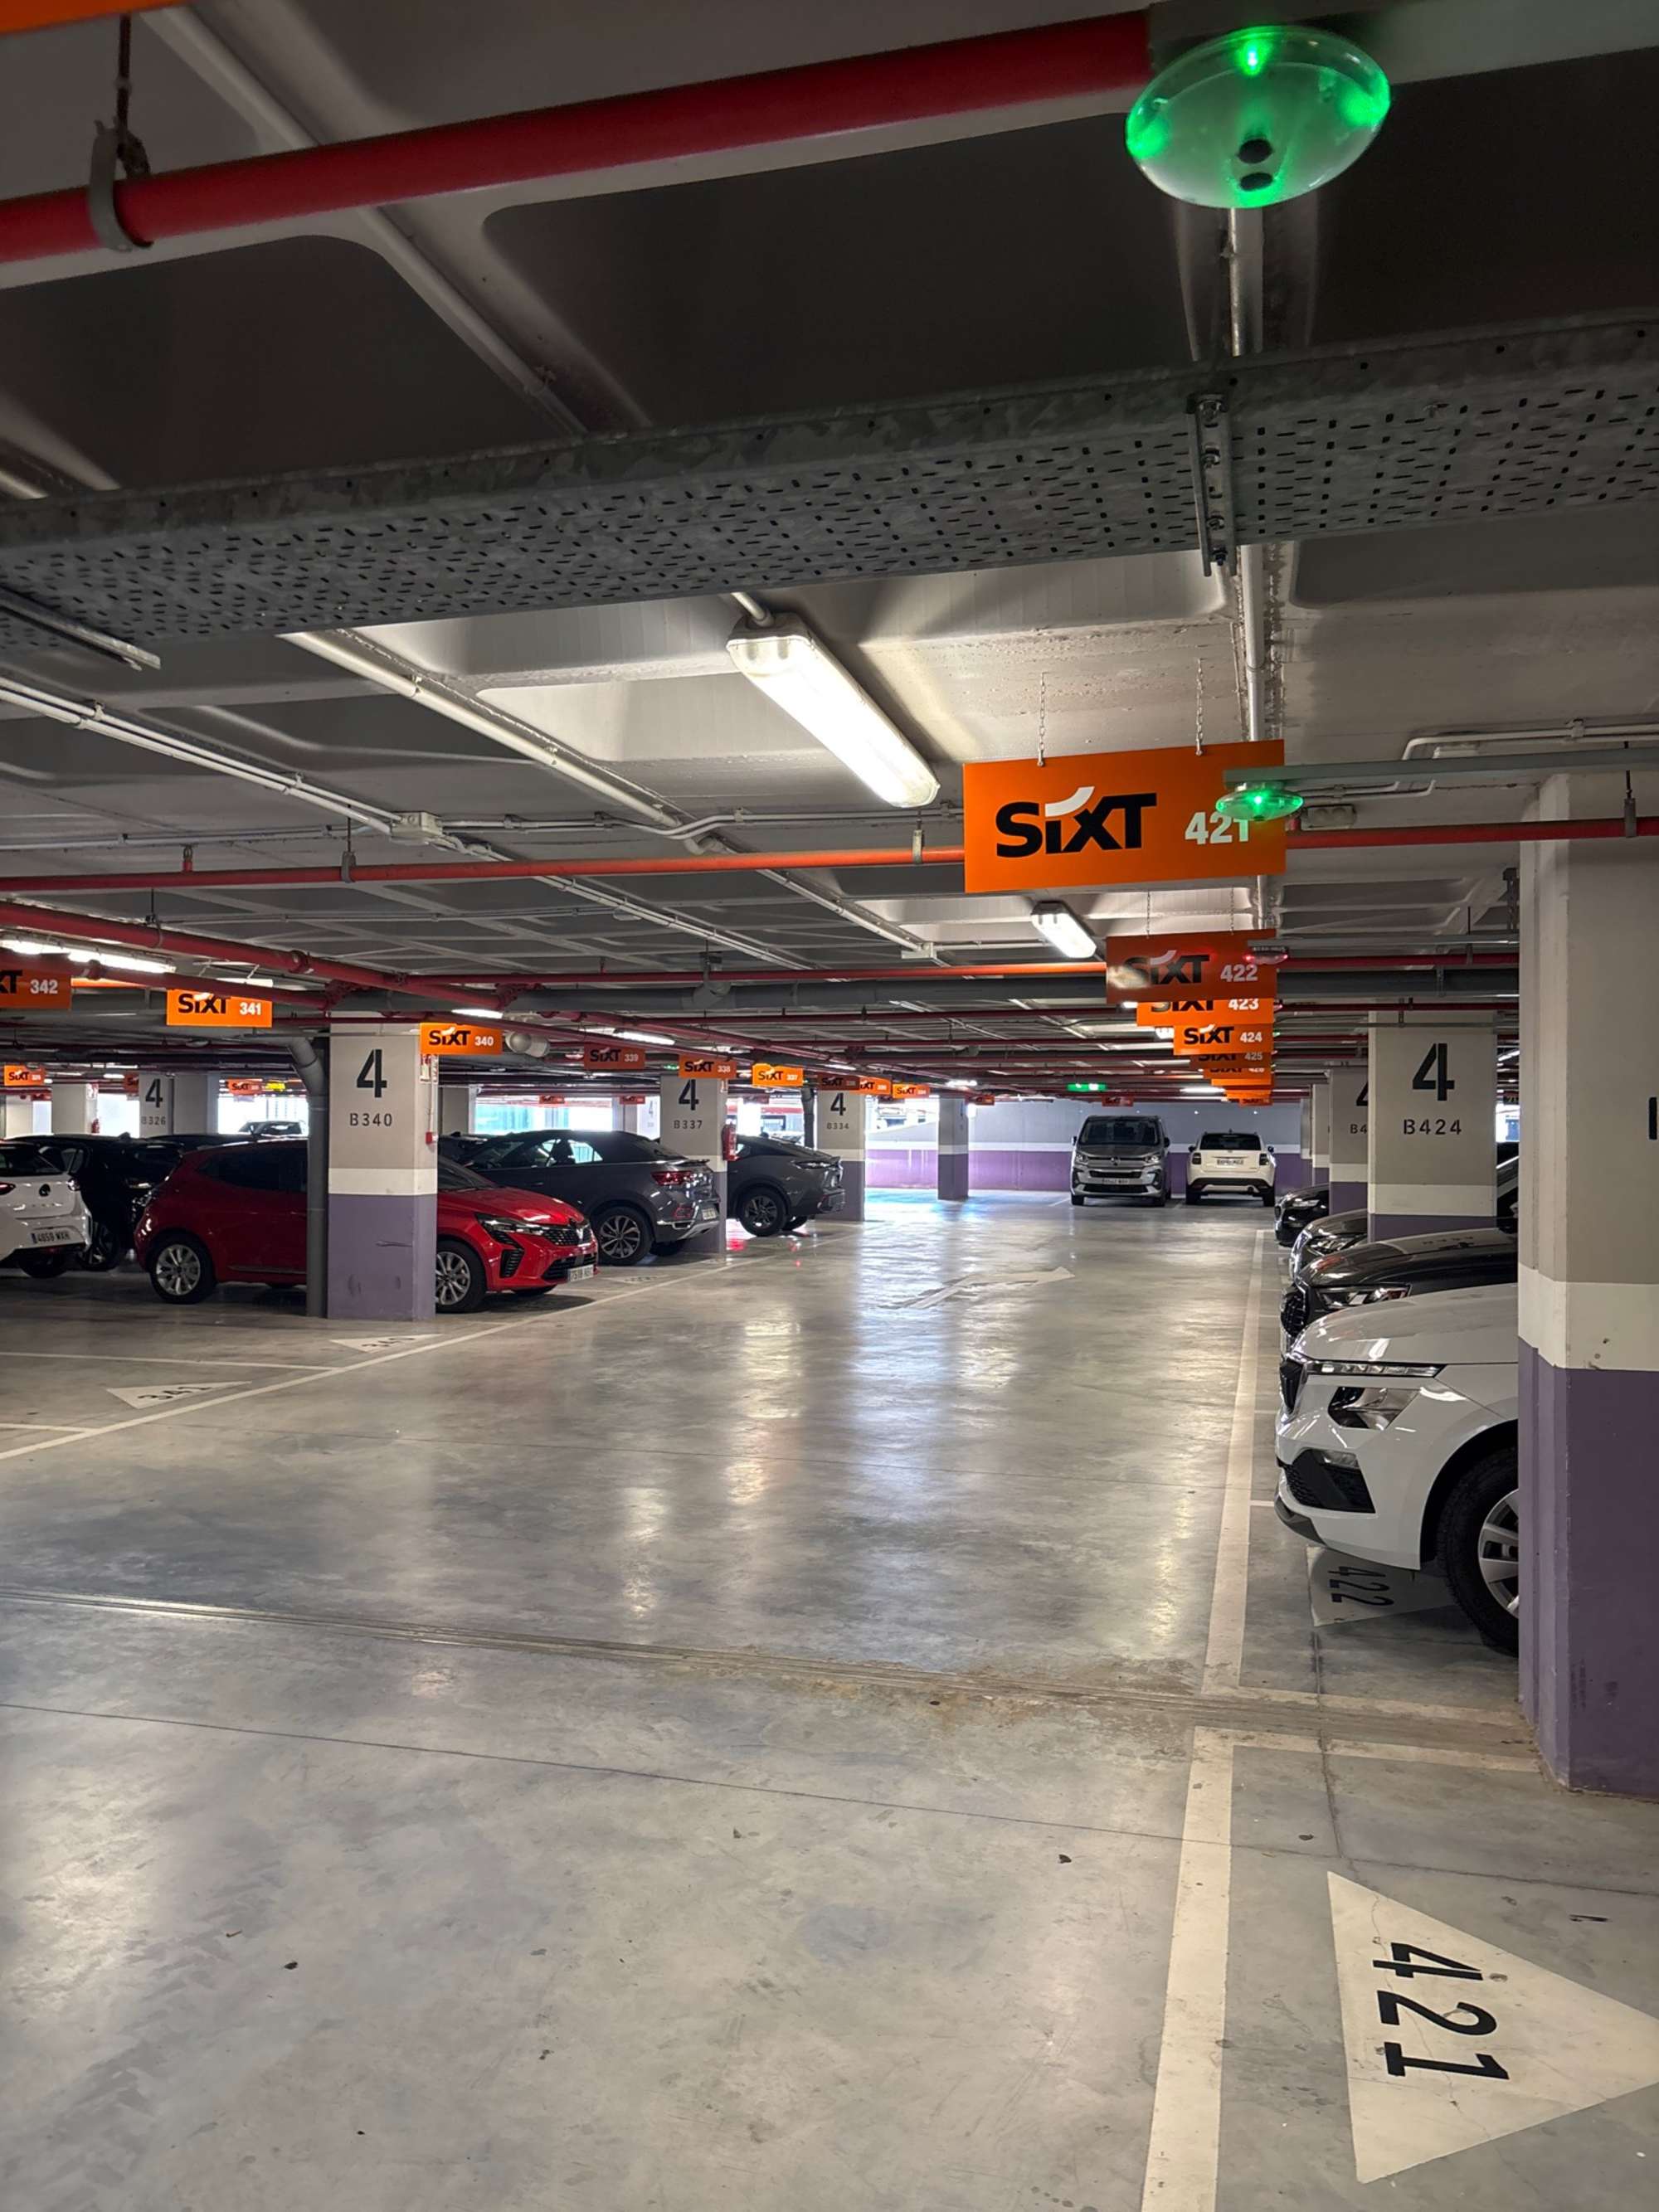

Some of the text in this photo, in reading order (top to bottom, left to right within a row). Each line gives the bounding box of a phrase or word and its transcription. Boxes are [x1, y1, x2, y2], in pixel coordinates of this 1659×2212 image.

[1185, 811, 1249, 844] 421
[1220, 965, 1258, 982] 422
[30, 980, 58, 994] 342
[239, 1002, 262, 1015] 341
[1228, 998, 1259, 1010] 423
[474, 1036, 494, 1046] 340
[1240, 1032, 1262, 1043] 424
[624, 1053, 639, 1062] 339
[356, 1049, 387, 1098] 4
[1413, 1043, 1455, 1101] 4
[145, 1078, 163, 1108] 4
[679, 1079, 699, 1111] 4
[830, 1092, 846, 1116] 4
[141, 1116, 166, 1125] B326
[349, 1113, 392, 1127] B340
[674, 1121, 703, 1129] B337
[1404, 1119, 1462, 1135] B424
[1328, 1566, 1394, 1606] 422
[1373, 1942, 1510, 2080] 421
